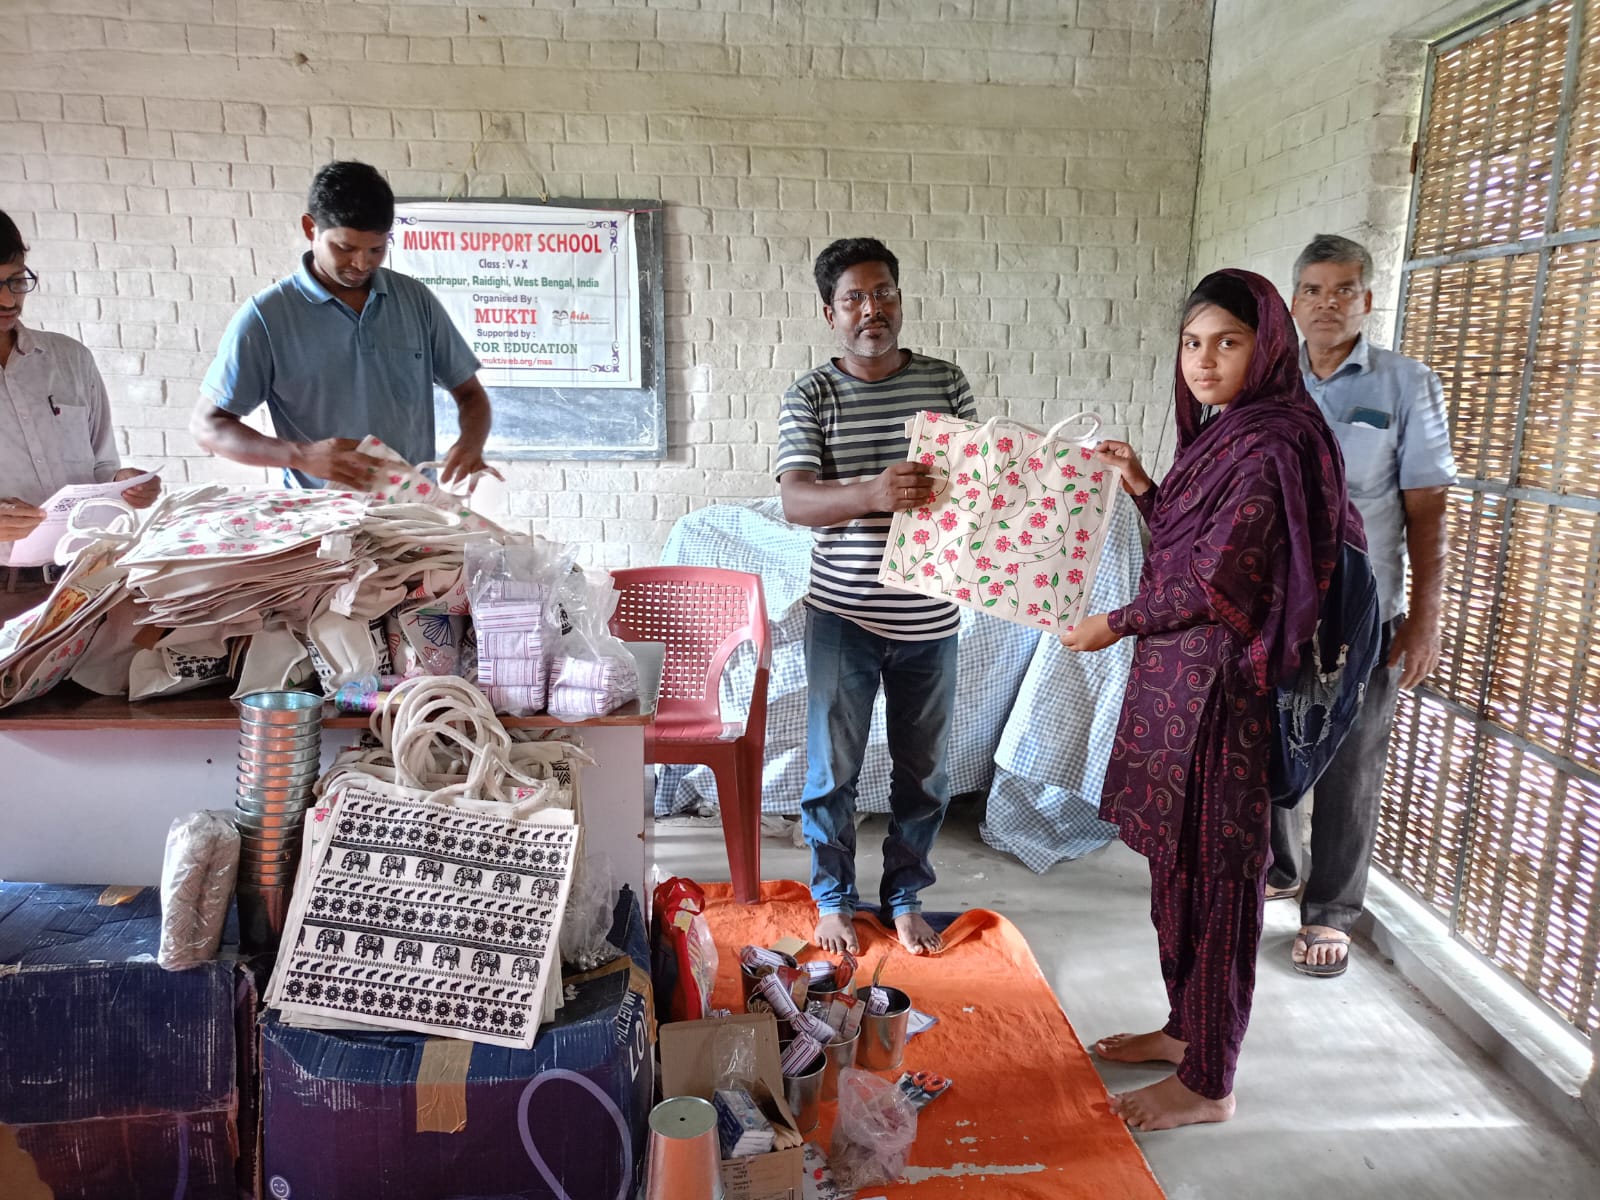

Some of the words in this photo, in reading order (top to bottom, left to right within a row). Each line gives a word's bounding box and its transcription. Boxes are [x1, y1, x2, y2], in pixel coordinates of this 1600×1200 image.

[403, 230, 455, 250] MUKTI
[460, 232, 532, 252] SUPPORT
[538, 233, 602, 254] SCHOOL
[478, 259, 500, 269] Class
[507, 259, 514, 269] V
[521, 259, 528, 269] X
[472, 275, 511, 289] Raidighi,
[513, 276, 540, 287] West
[541, 277, 575, 290] Bengal,
[577, 278, 599, 288] India
[472, 294, 518, 304] Organised
[520, 294, 532, 305] By
[474, 308, 537, 325] MUKTI
[477, 328, 518, 339] Supported
[520, 330, 531, 339] by
[473, 341, 499, 353] FOR
[504, 342, 578, 354] EDUCATION
